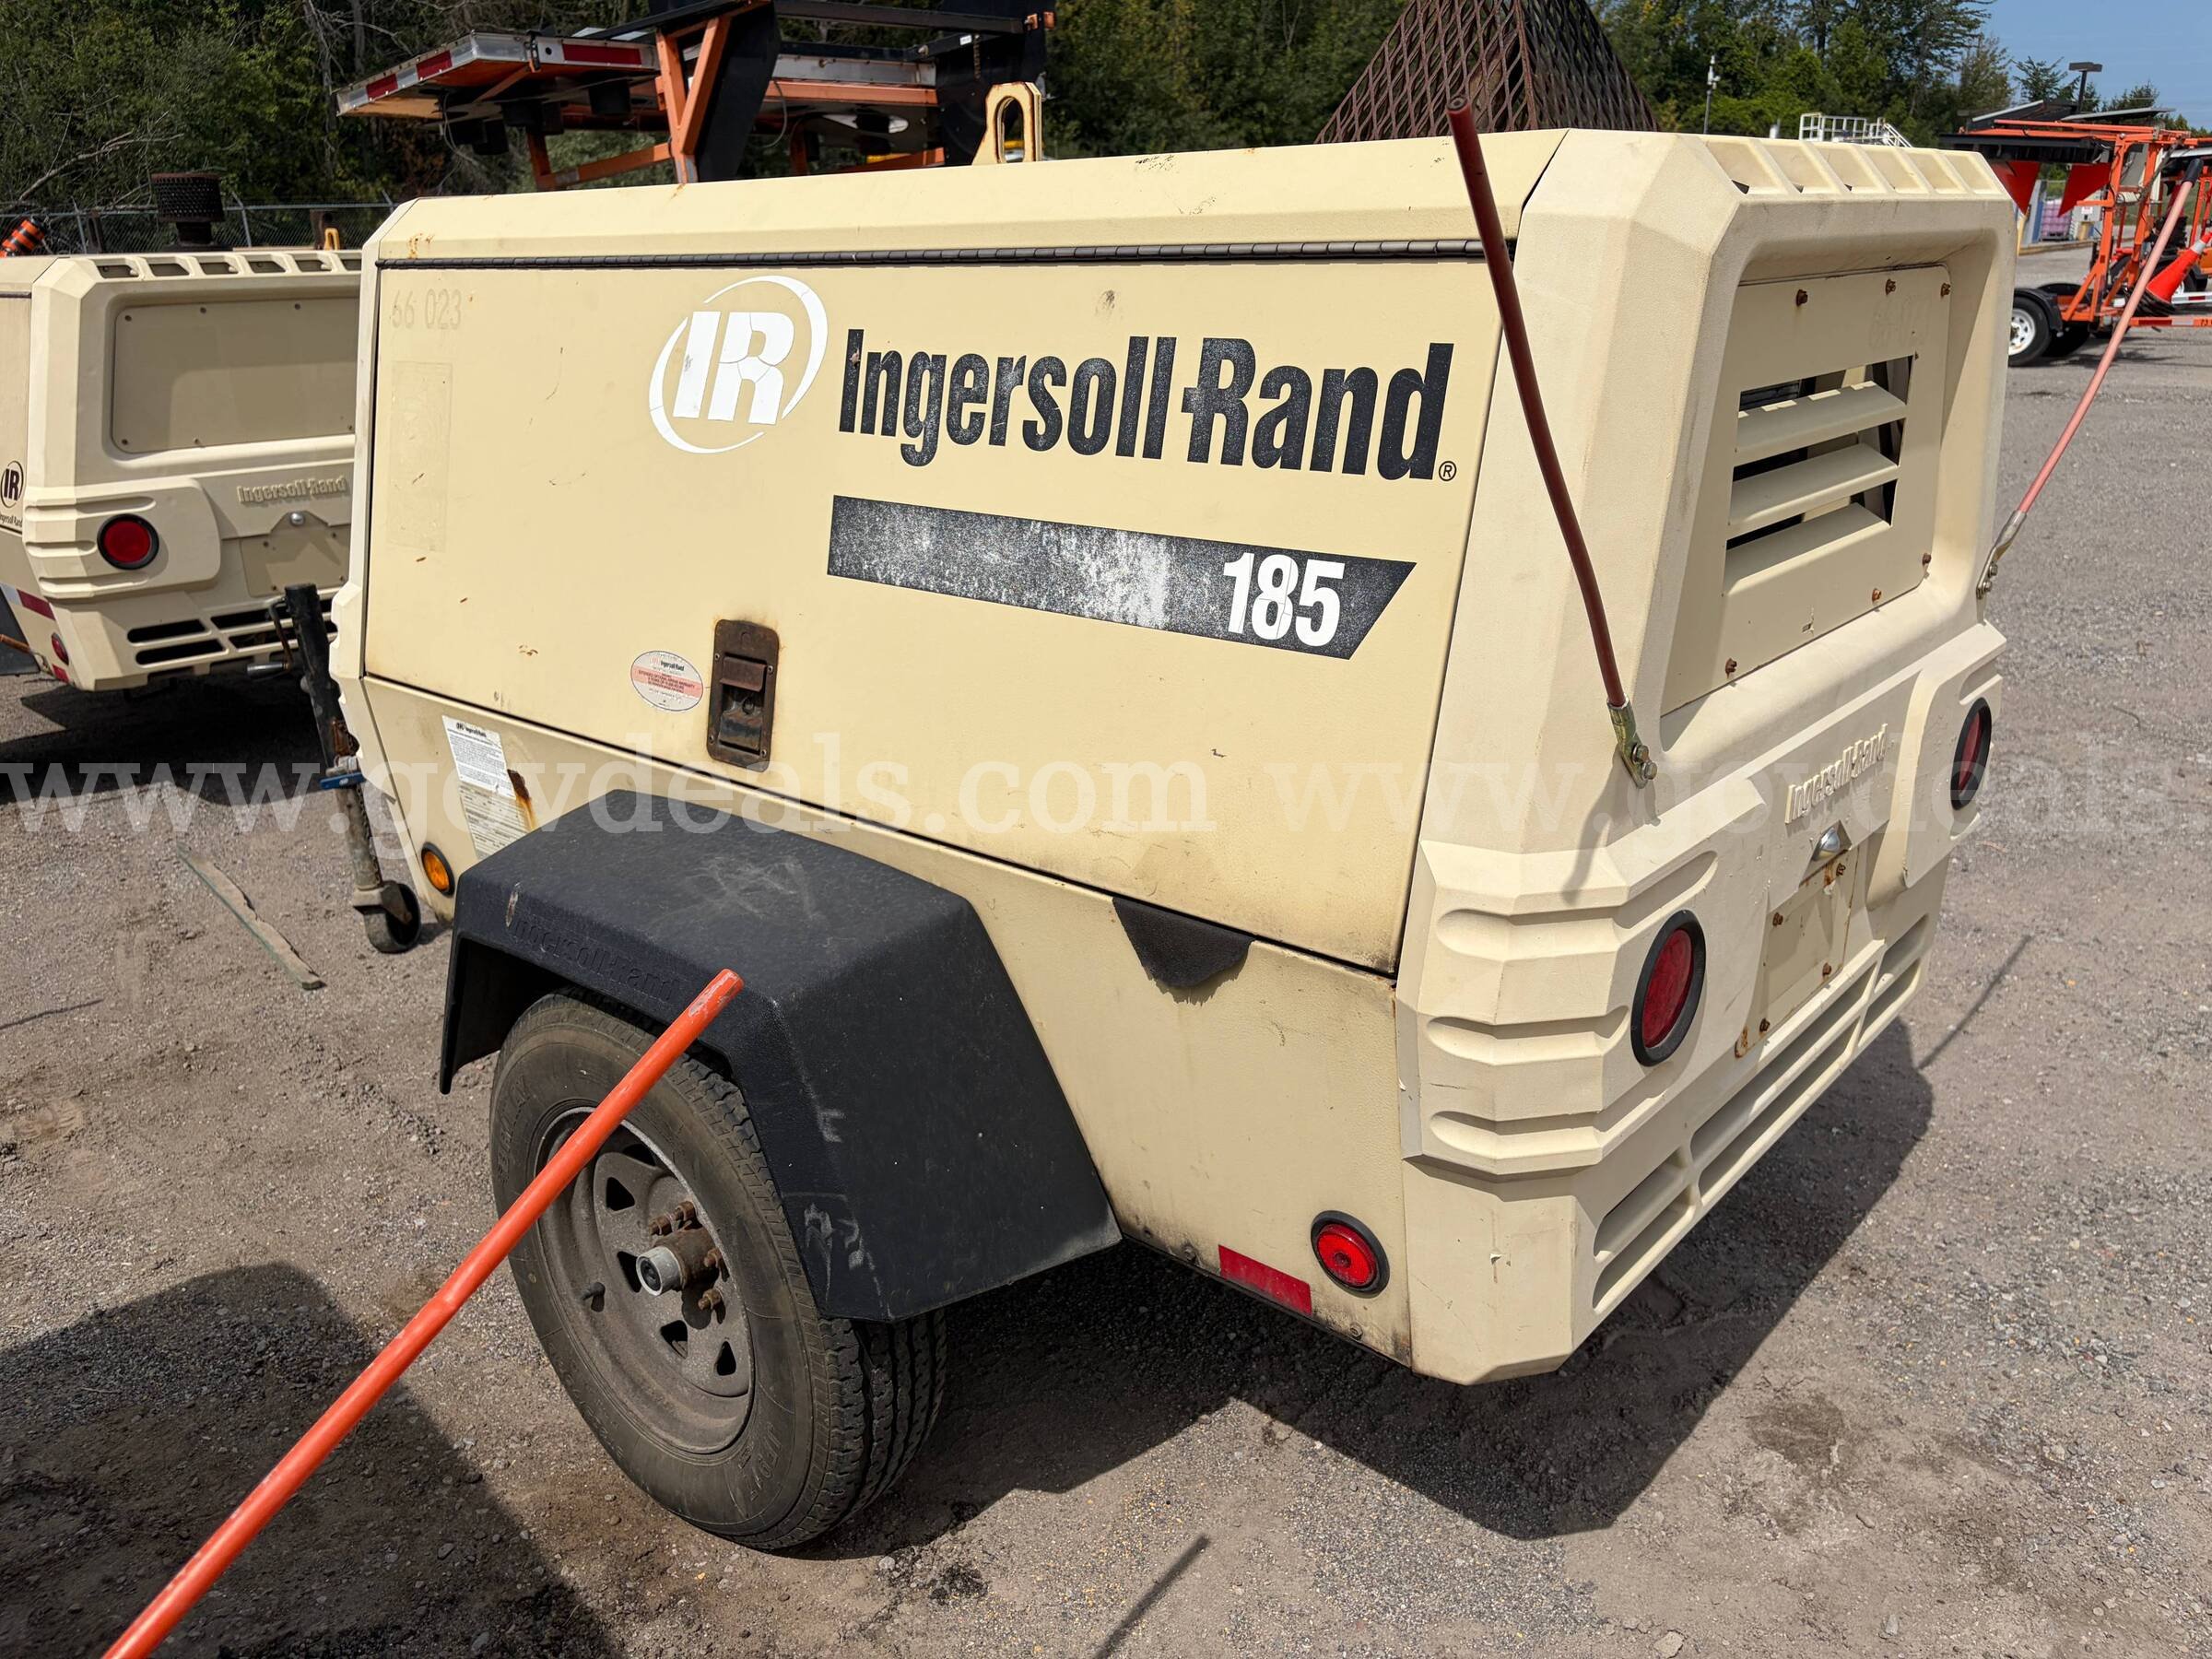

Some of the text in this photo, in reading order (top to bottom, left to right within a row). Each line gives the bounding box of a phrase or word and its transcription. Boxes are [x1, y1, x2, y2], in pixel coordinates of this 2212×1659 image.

[673, 311, 795, 425] IR
[839, 328, 1453, 480] Ingersoll-Rand
[1223, 552, 1346, 647] 185
